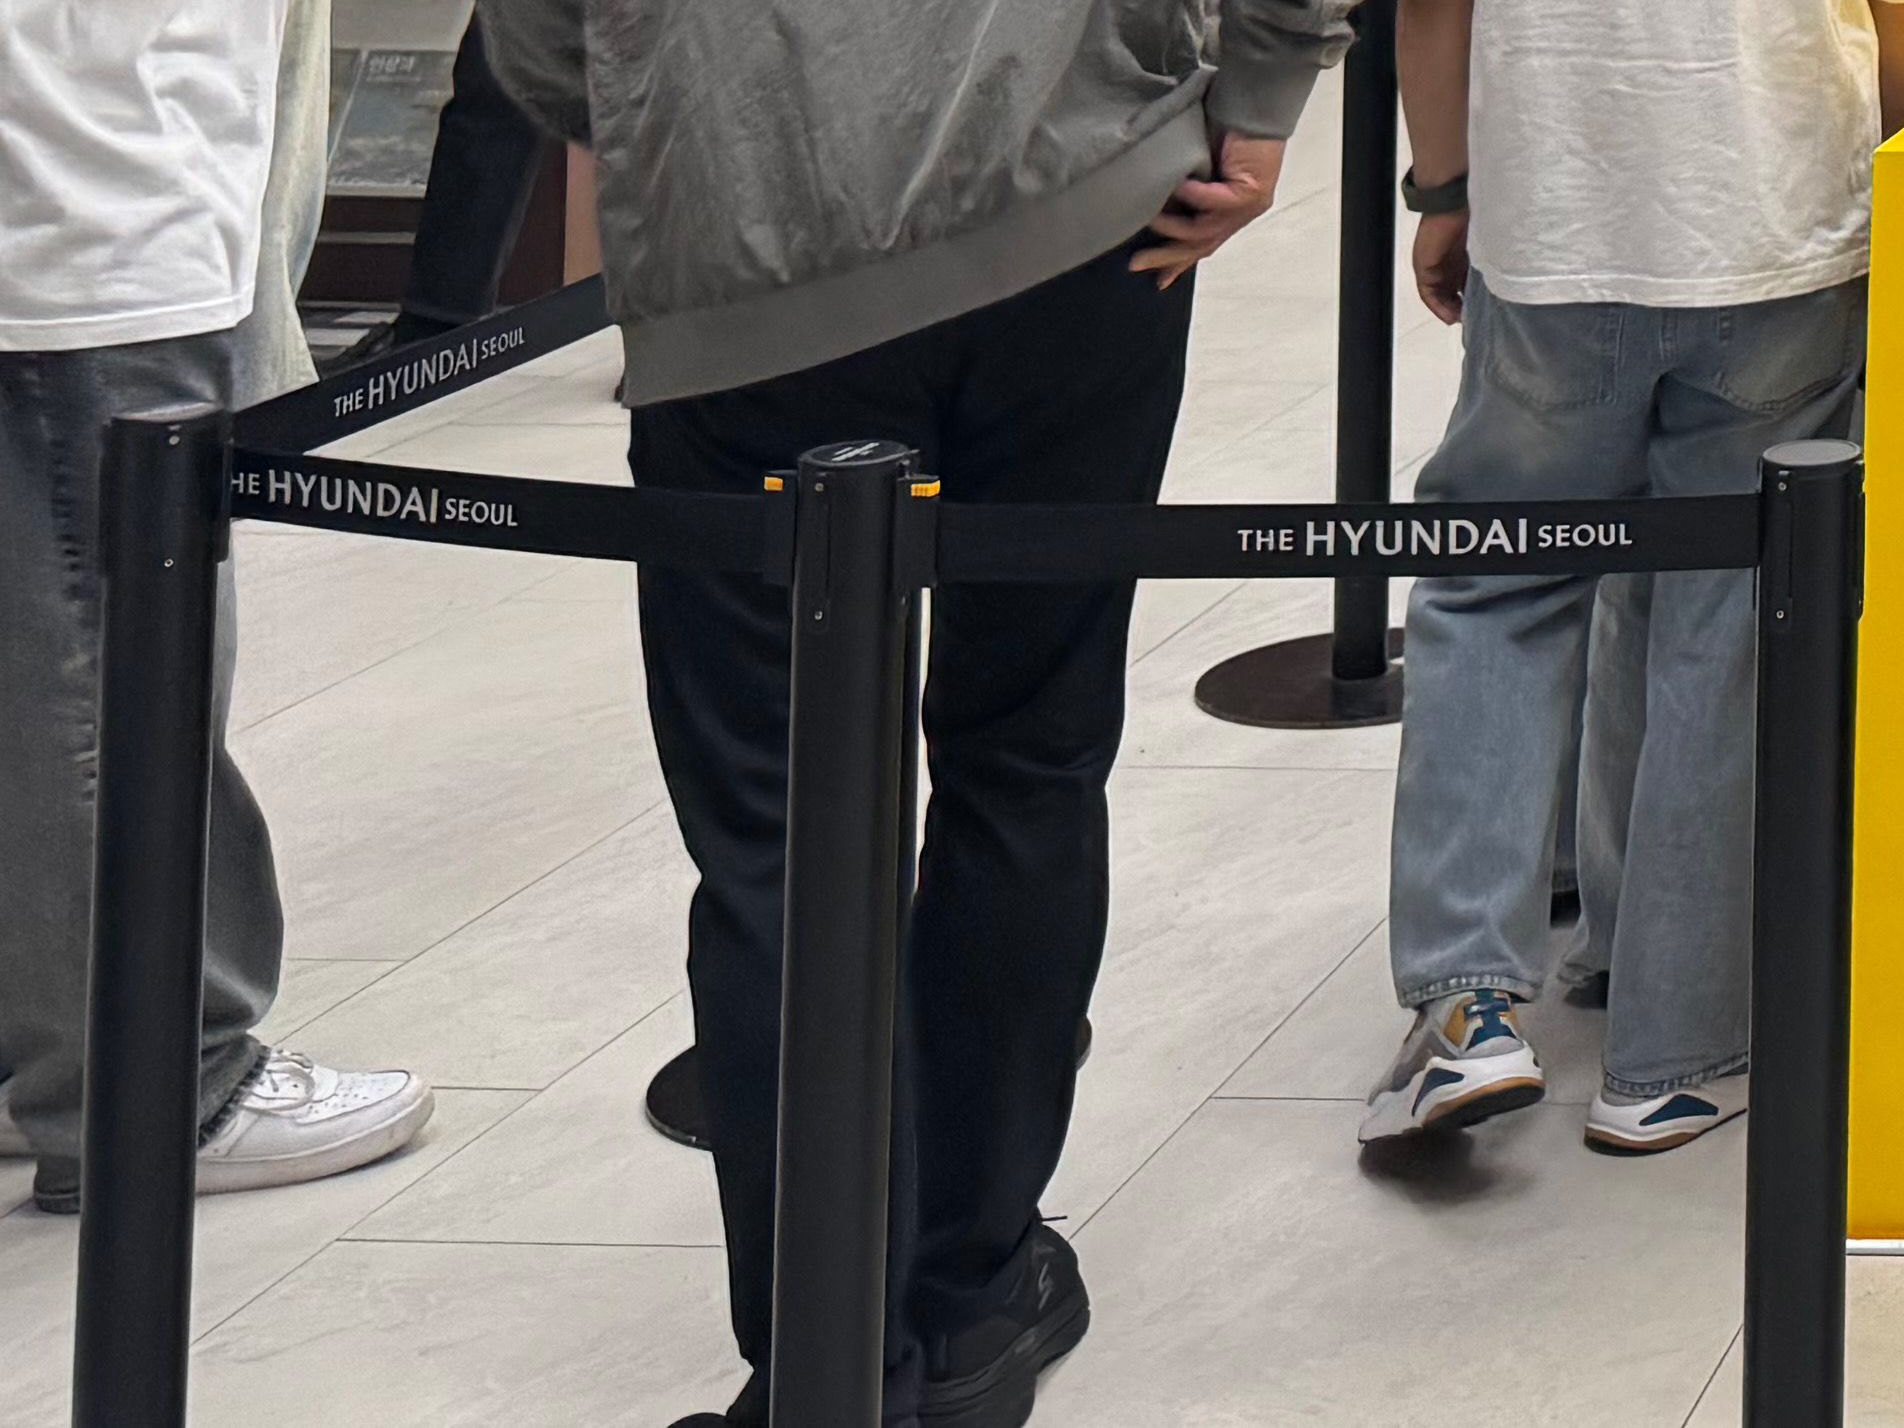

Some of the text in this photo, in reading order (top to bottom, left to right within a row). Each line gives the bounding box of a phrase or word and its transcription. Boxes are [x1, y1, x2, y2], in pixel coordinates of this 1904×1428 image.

[334, 326, 525, 418] THE HYUNDAI SEOUL
[230, 470, 518, 528] HE HYUNDAI SEOUL
[1238, 518, 1633, 556] THE HYUNDAI SEOUL
